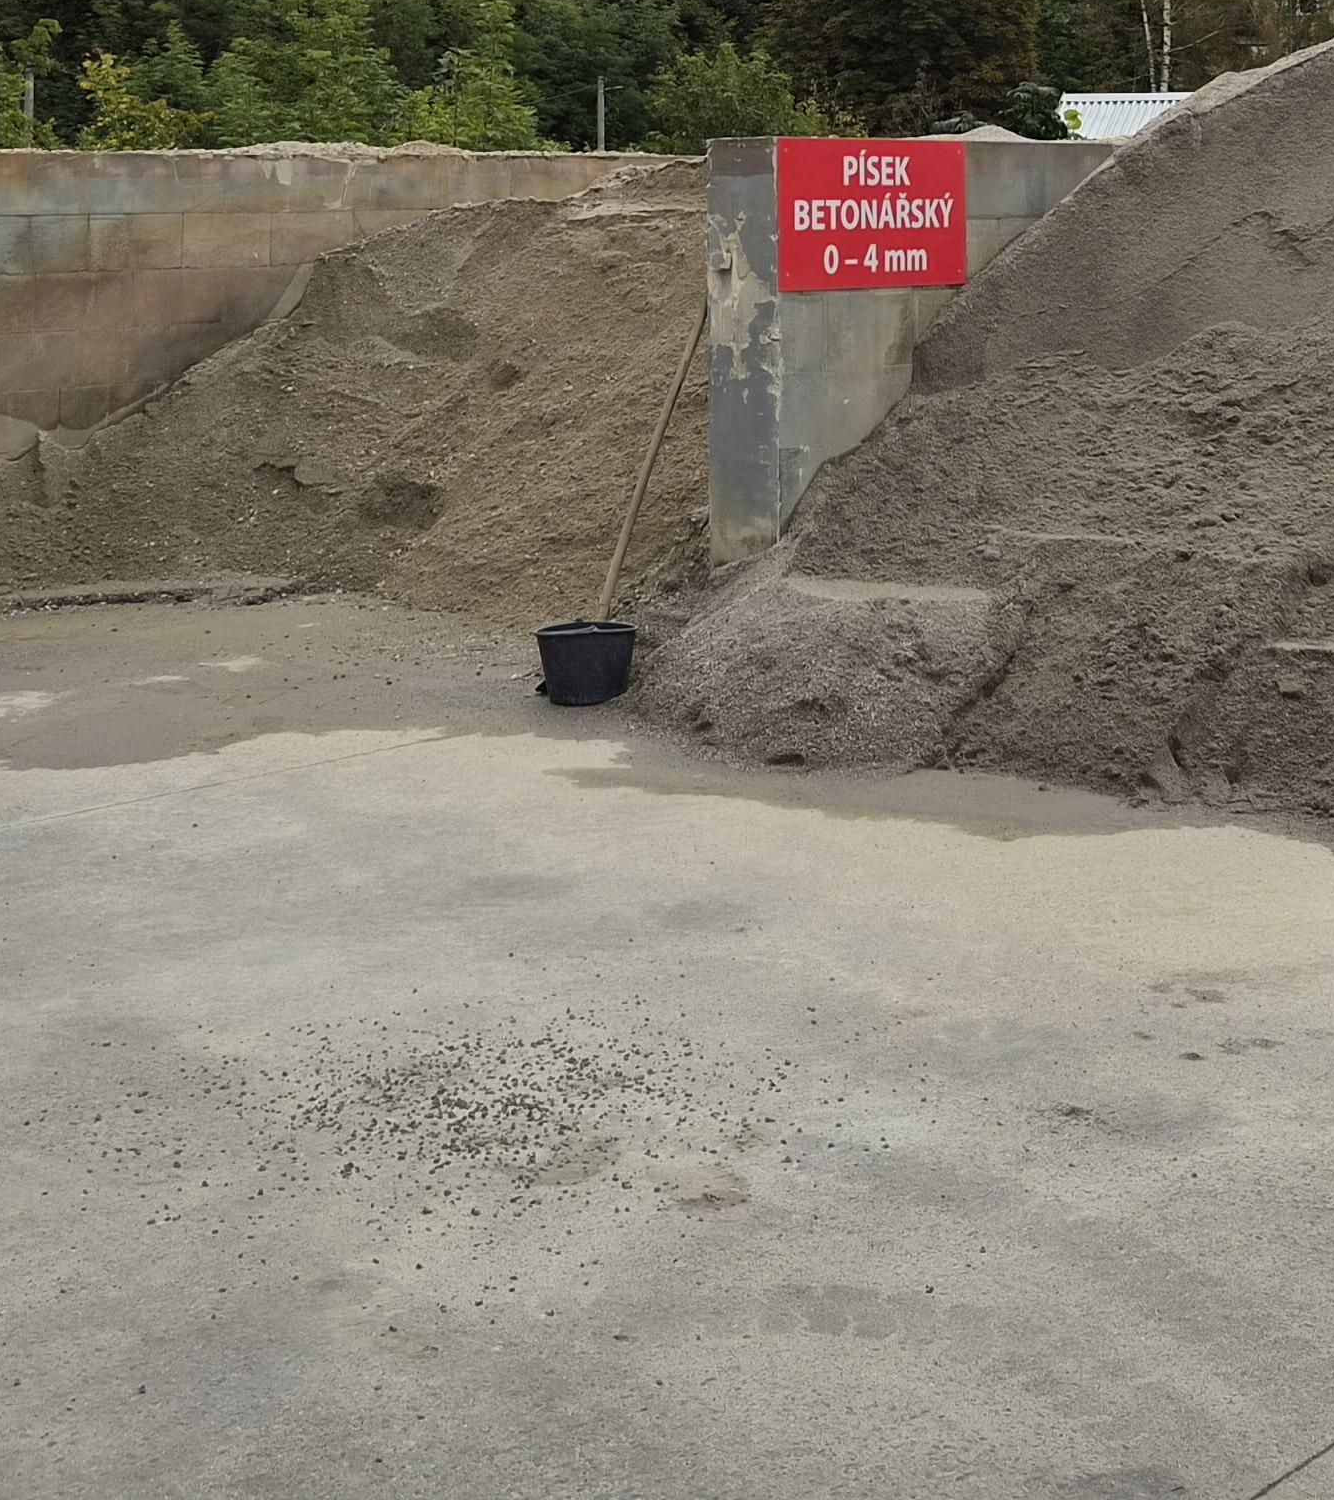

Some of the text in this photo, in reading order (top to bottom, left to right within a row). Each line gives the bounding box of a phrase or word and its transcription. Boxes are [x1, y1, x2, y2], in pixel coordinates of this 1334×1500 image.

[843, 149, 911, 187] PÍSEK
[794, 192, 954, 231] BETONÁŘSKÝ
[823, 244, 839, 275] 0
[863, 243, 879, 273] 4
[884, 248, 928, 273] mm
